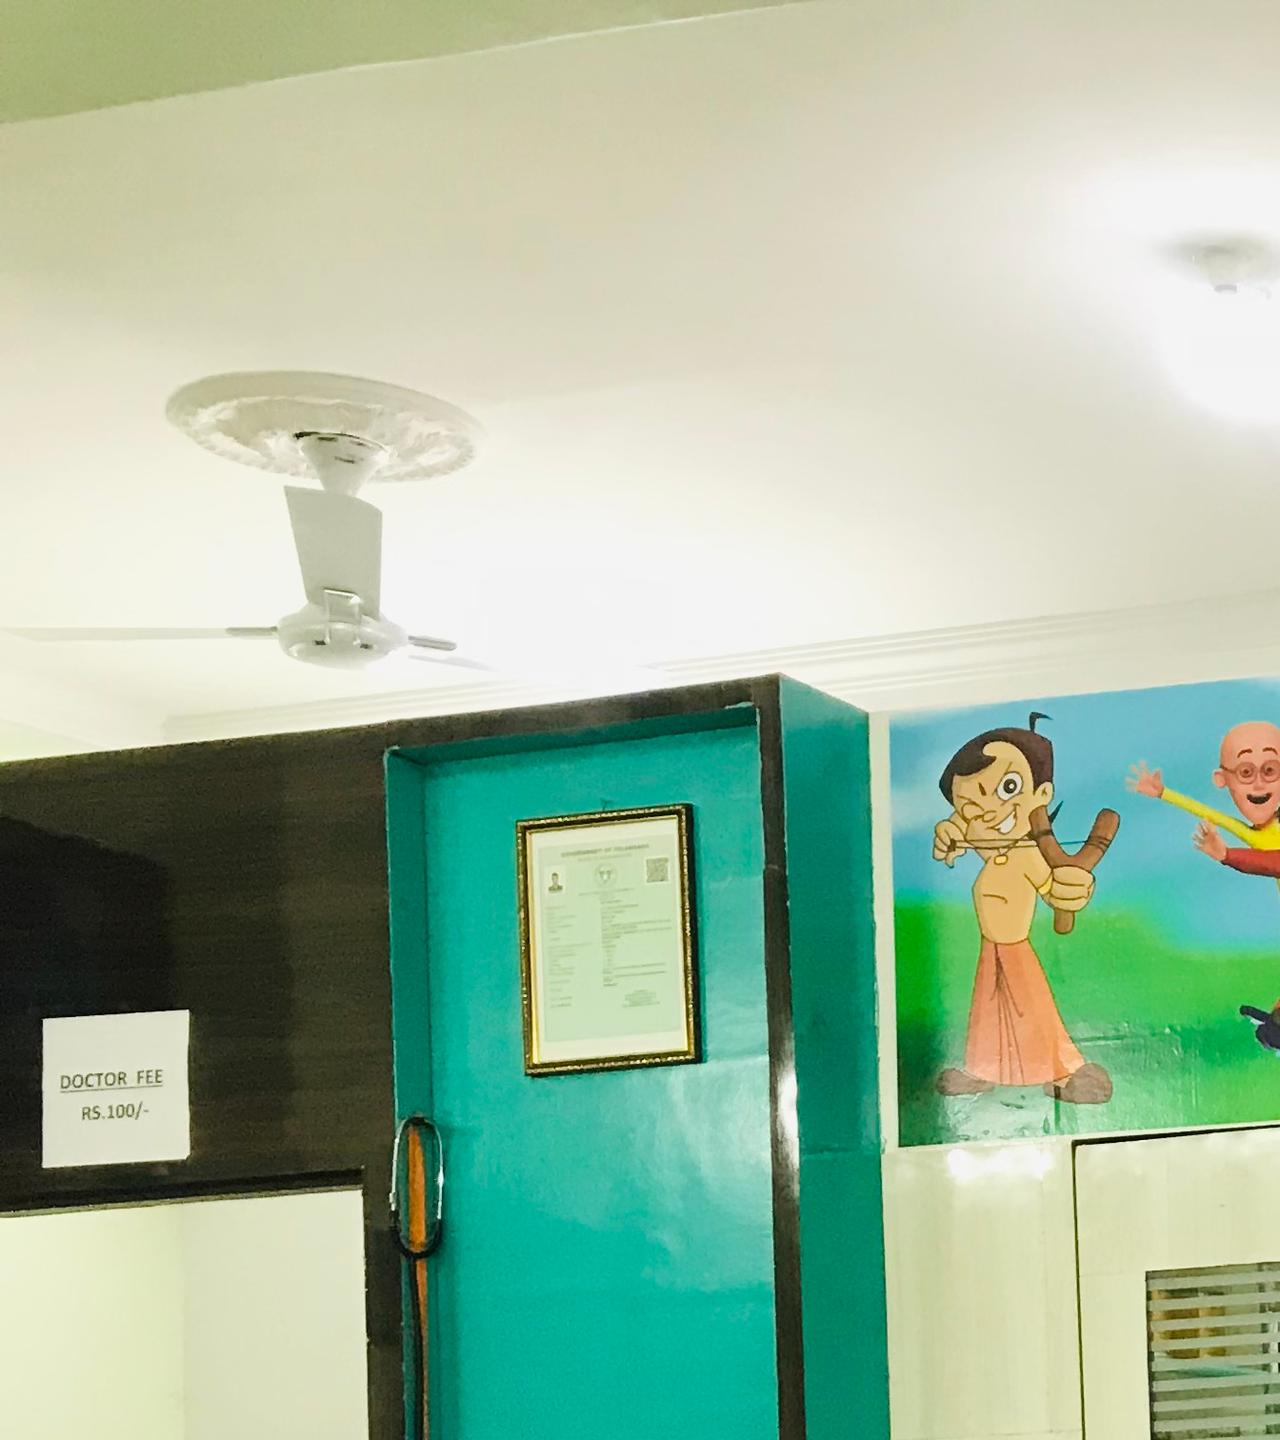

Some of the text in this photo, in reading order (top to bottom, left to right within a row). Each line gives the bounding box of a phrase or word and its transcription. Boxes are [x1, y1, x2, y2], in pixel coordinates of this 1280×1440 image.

[60, 1069, 163, 1089] DOCTOR FEE
[82, 1101, 149, 1120] RS.100/-
